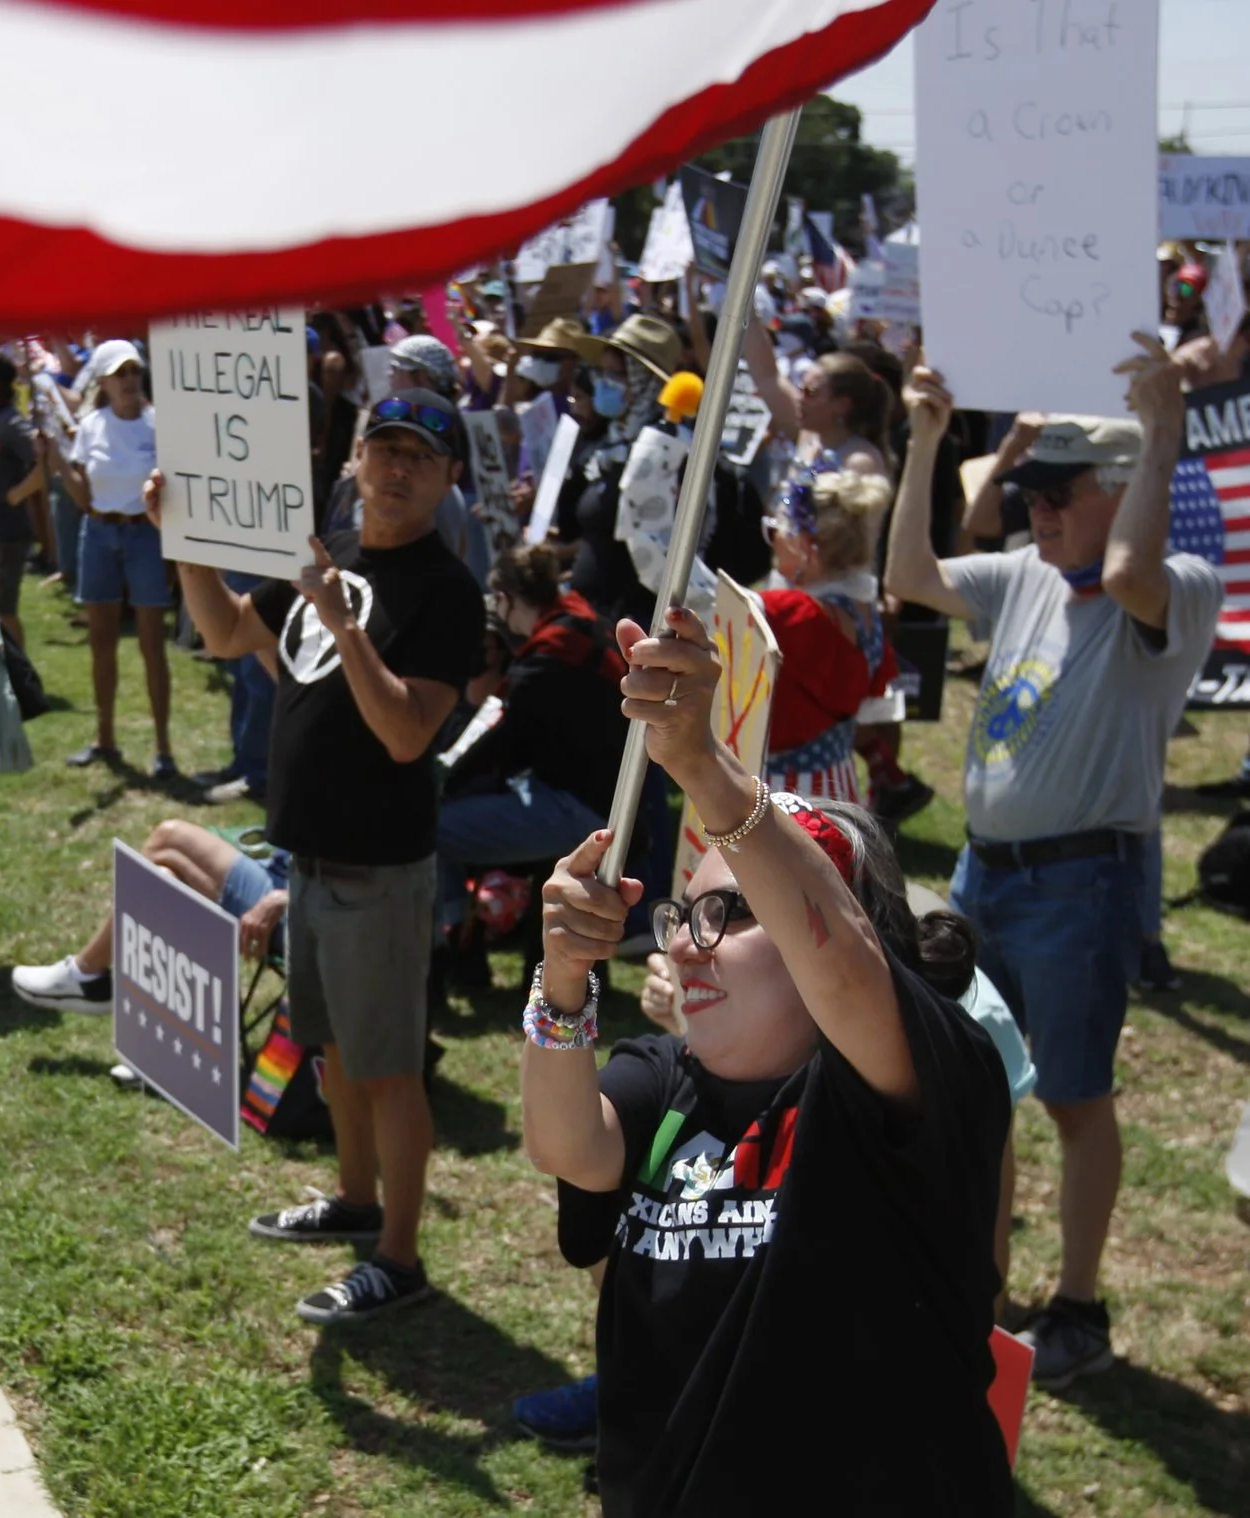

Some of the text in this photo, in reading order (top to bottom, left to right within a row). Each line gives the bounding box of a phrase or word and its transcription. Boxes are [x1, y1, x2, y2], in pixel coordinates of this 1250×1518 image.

[945, 1, 1001, 61] Is
[967, 101, 1113, 141] a Crown
[1006, 180, 1045, 205] or
[961, 228, 983, 249] a
[169, 350, 299, 400] ILLEGAL
[214, 412, 250, 462] IS
[174, 471, 305, 532] TRUMP
[122, 912, 222, 1046] RESIST!
